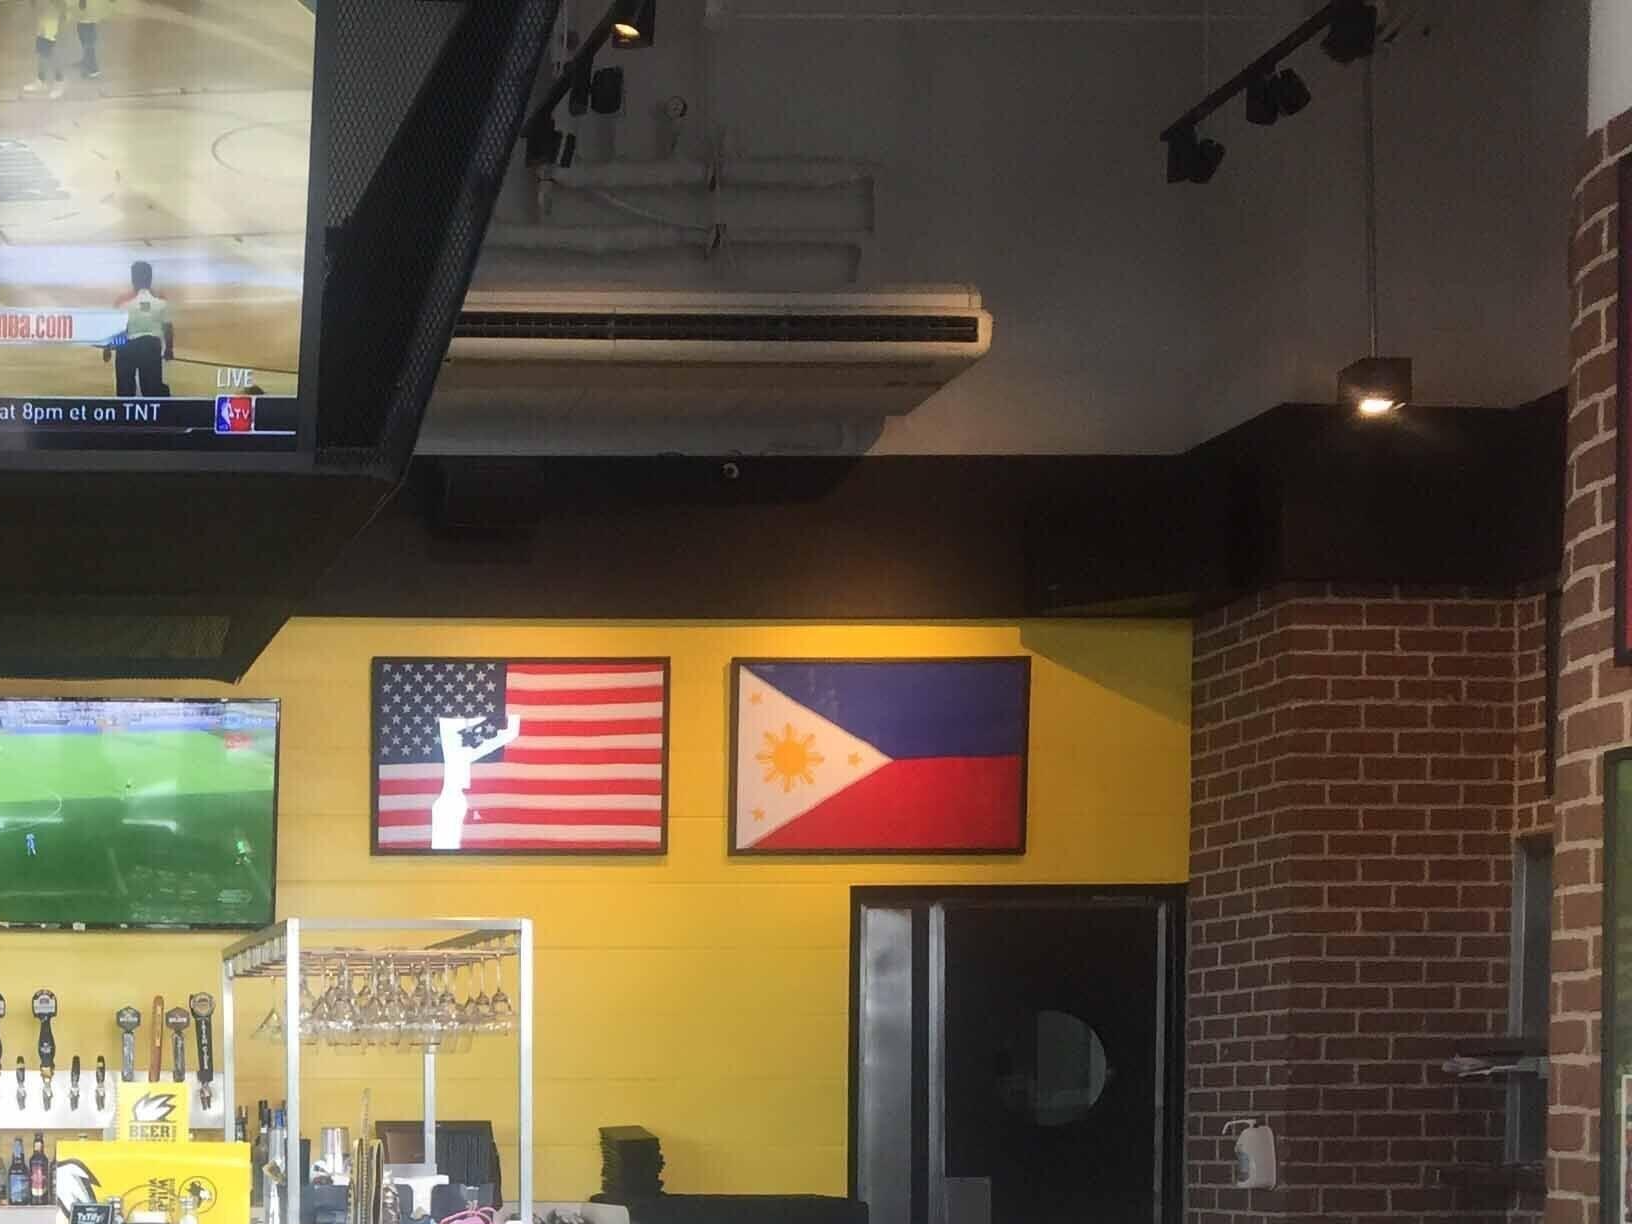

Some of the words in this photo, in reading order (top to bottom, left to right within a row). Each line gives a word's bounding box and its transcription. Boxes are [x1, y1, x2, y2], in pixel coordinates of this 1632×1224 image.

[217, 368, 253, 387] LIVE
[0, 405, 16, 421] at
[22, 403, 64, 424] 8pm
[69, 406, 89, 422] et
[94, 408, 116, 422] on
[122, 404, 161, 422] TNT
[233, 408, 250, 420] TV
[128, 1125, 171, 1138] BEER
